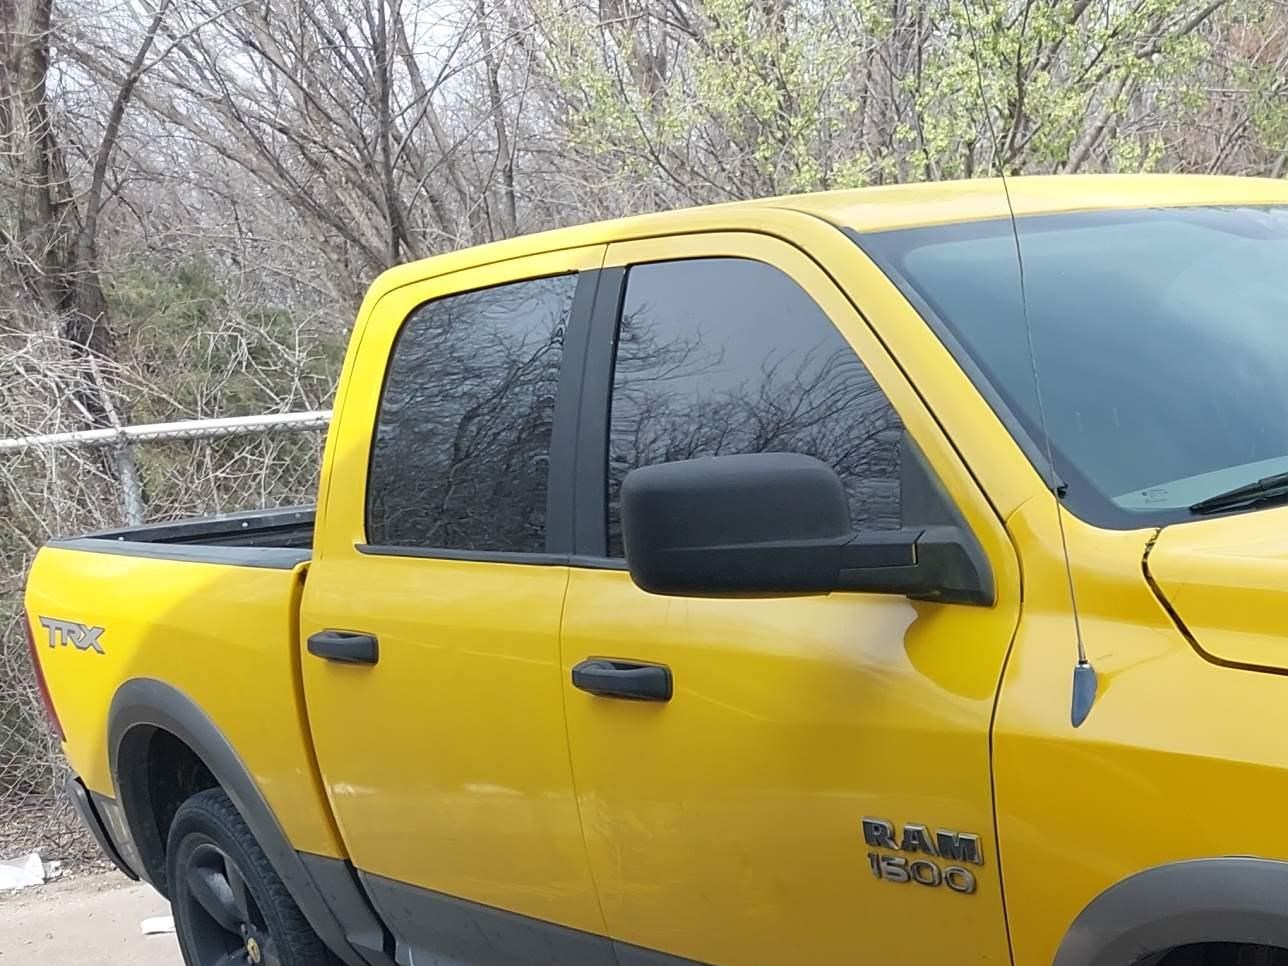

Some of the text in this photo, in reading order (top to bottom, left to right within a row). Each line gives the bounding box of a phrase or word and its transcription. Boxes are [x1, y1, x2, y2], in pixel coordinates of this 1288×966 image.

[39, 616, 105, 655] TRX
[861, 816, 984, 866] RAM
[867, 852, 977, 894] 1500
